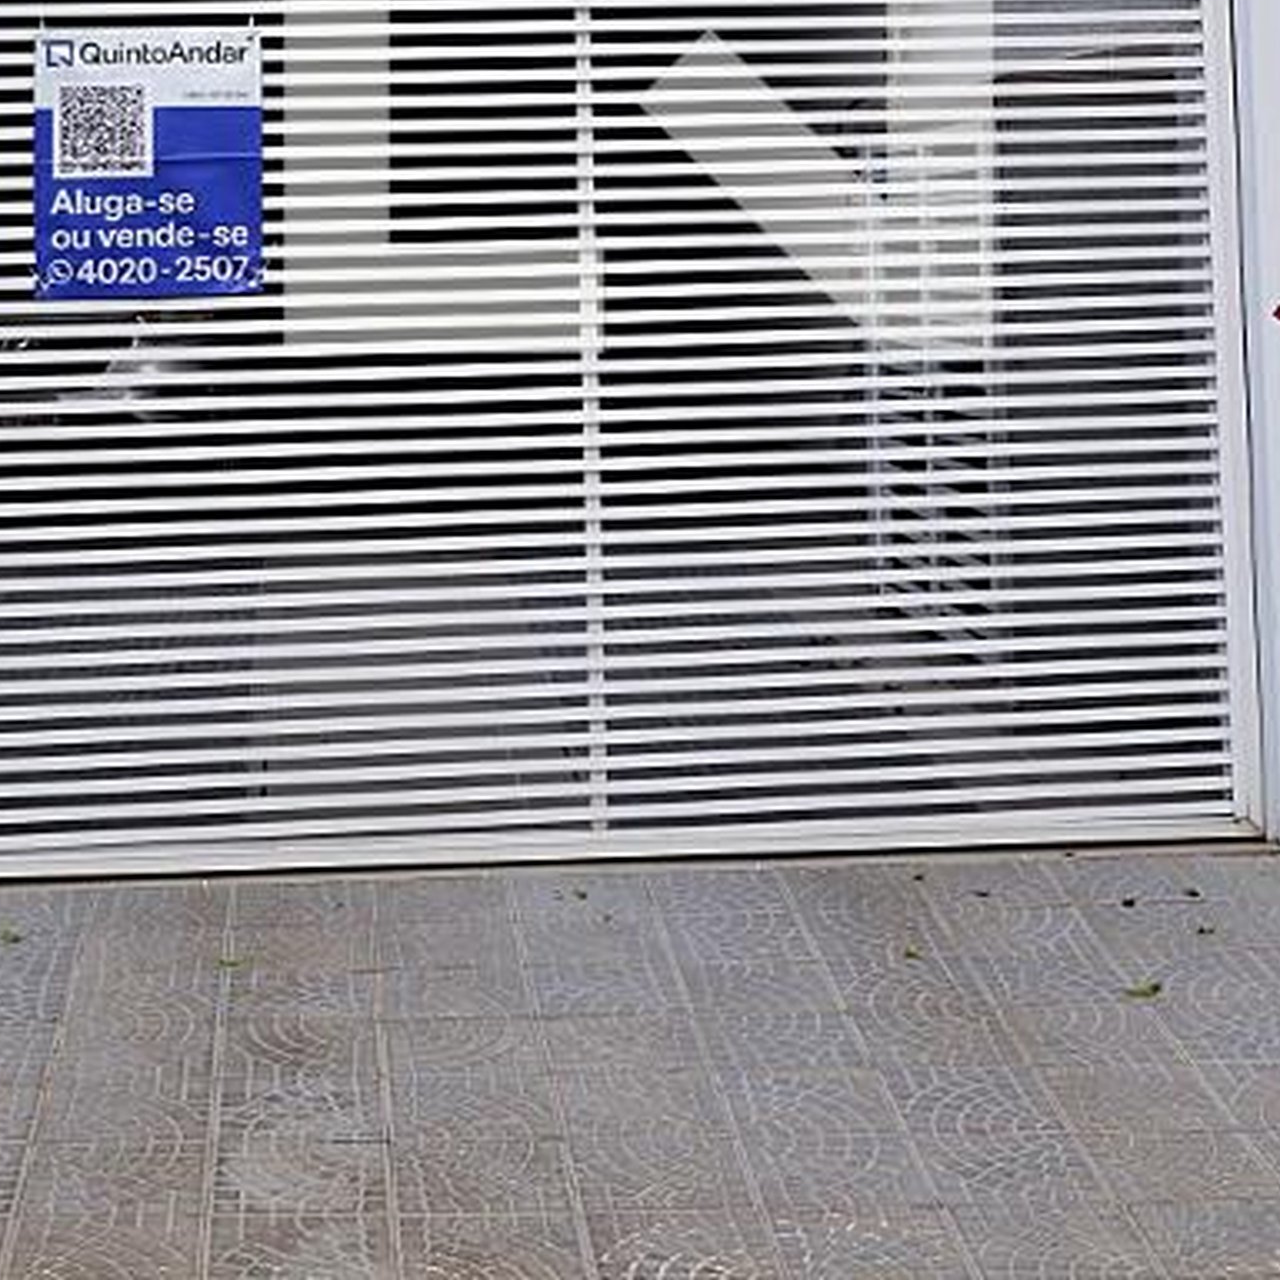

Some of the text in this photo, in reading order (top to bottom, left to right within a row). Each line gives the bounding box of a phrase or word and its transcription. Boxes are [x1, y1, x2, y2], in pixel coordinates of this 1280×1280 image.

[79, 40, 248, 65] QuintoAndar
[51, 189, 195, 221] Aluga-se
[51, 221, 248, 250] ou vende-se
[76, 255, 249, 285] 4020-2507
